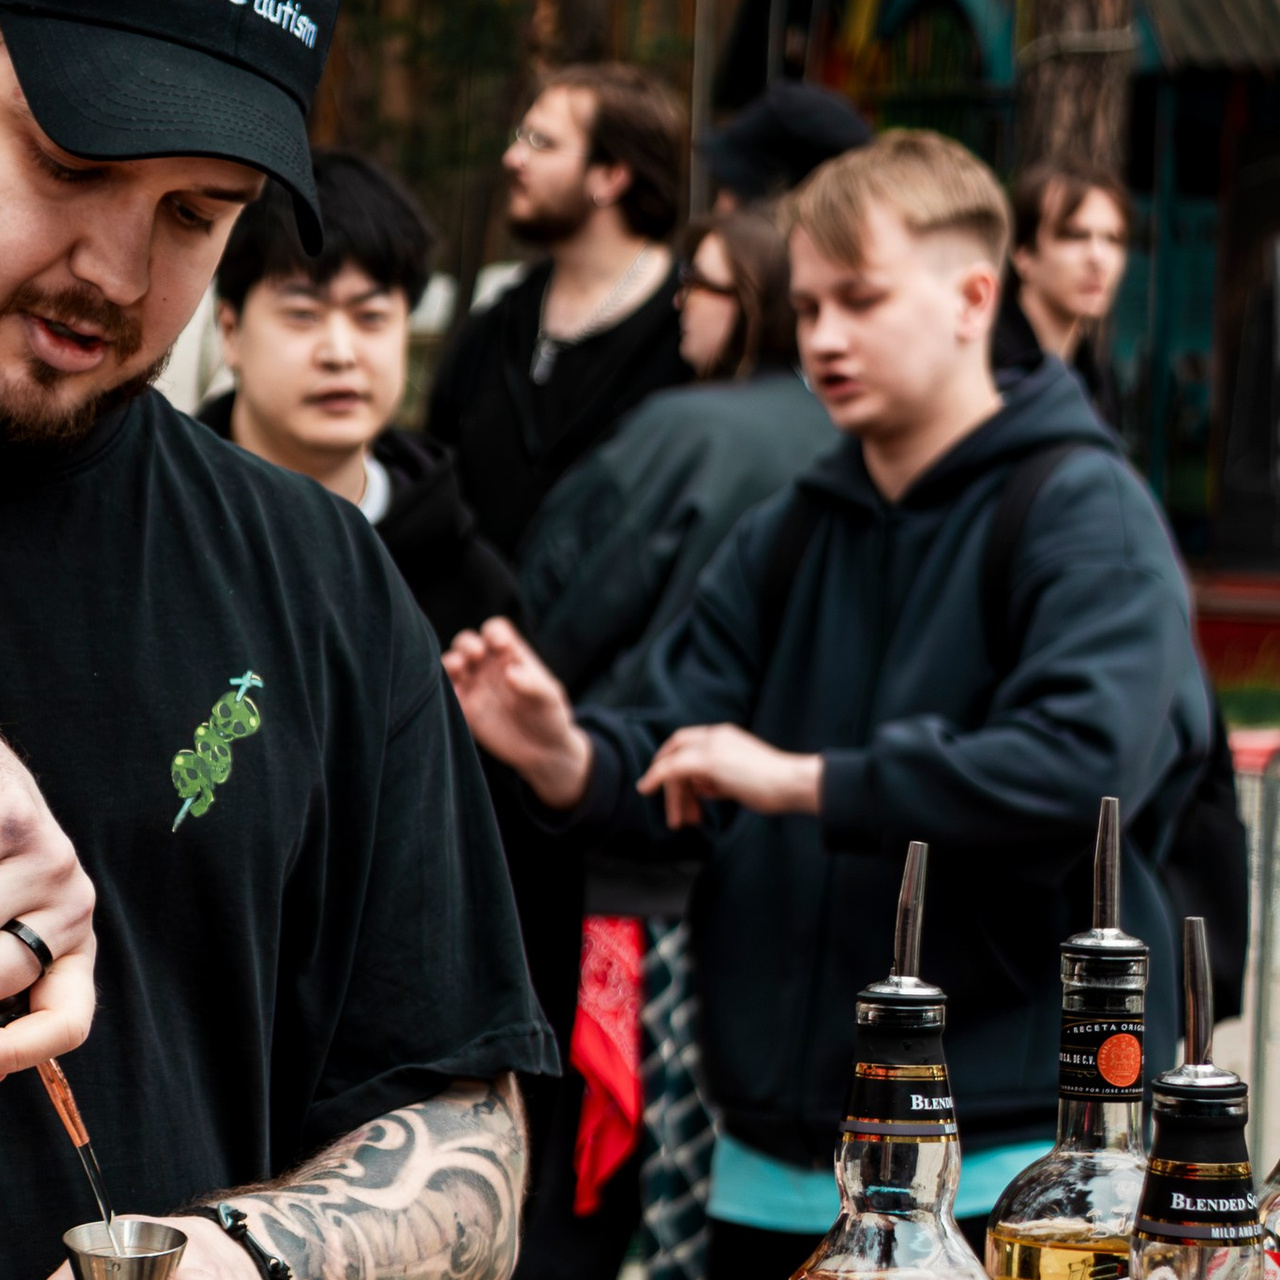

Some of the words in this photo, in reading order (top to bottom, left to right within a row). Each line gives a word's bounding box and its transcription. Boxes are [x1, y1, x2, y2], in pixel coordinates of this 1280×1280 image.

[1073, 1024, 1117, 1034] RECETA
[1170, 1192, 1246, 1212] BLENDED
[1211, 1227, 1236, 1239] MILD
